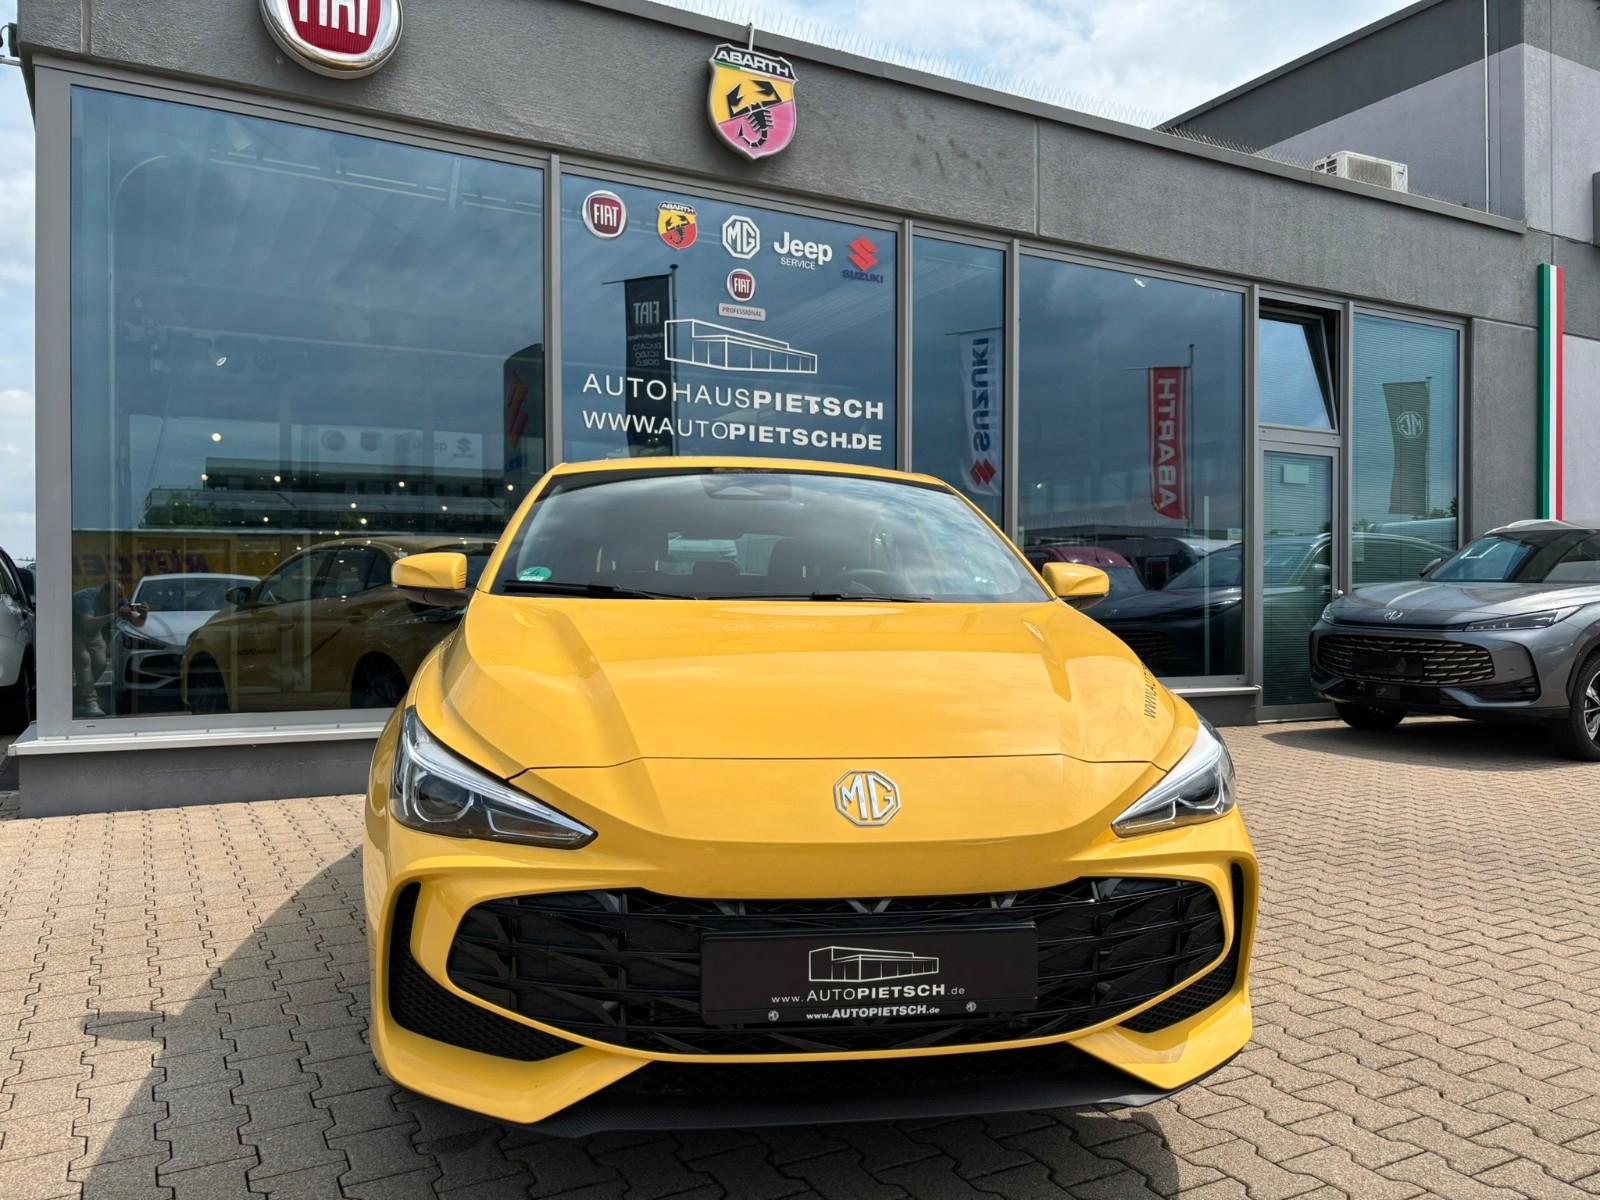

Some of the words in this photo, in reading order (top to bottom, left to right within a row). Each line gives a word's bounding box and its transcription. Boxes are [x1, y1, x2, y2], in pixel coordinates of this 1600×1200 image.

[717, 50, 789, 77] ABARTH
[593, 203, 619, 227] FIAT
[661, 202, 696, 214] ABARTH
[727, 221, 757, 254] MG
[773, 232, 833, 265] Jeep
[780, 257, 816, 270] SERVICE
[733, 278, 750, 293] FIAT
[842, 269, 884, 283] SUZUKI
[721, 306, 762, 318] PROFESSIONAL
[582, 373, 884, 420] AUTOHAUSPIETSCH
[582, 409, 883, 451] WWW.AUTOPIETSCH.DE
[840, 773, 895, 821] MG
[806, 1004, 940, 1020] www.AUTOPIETSCH.de
